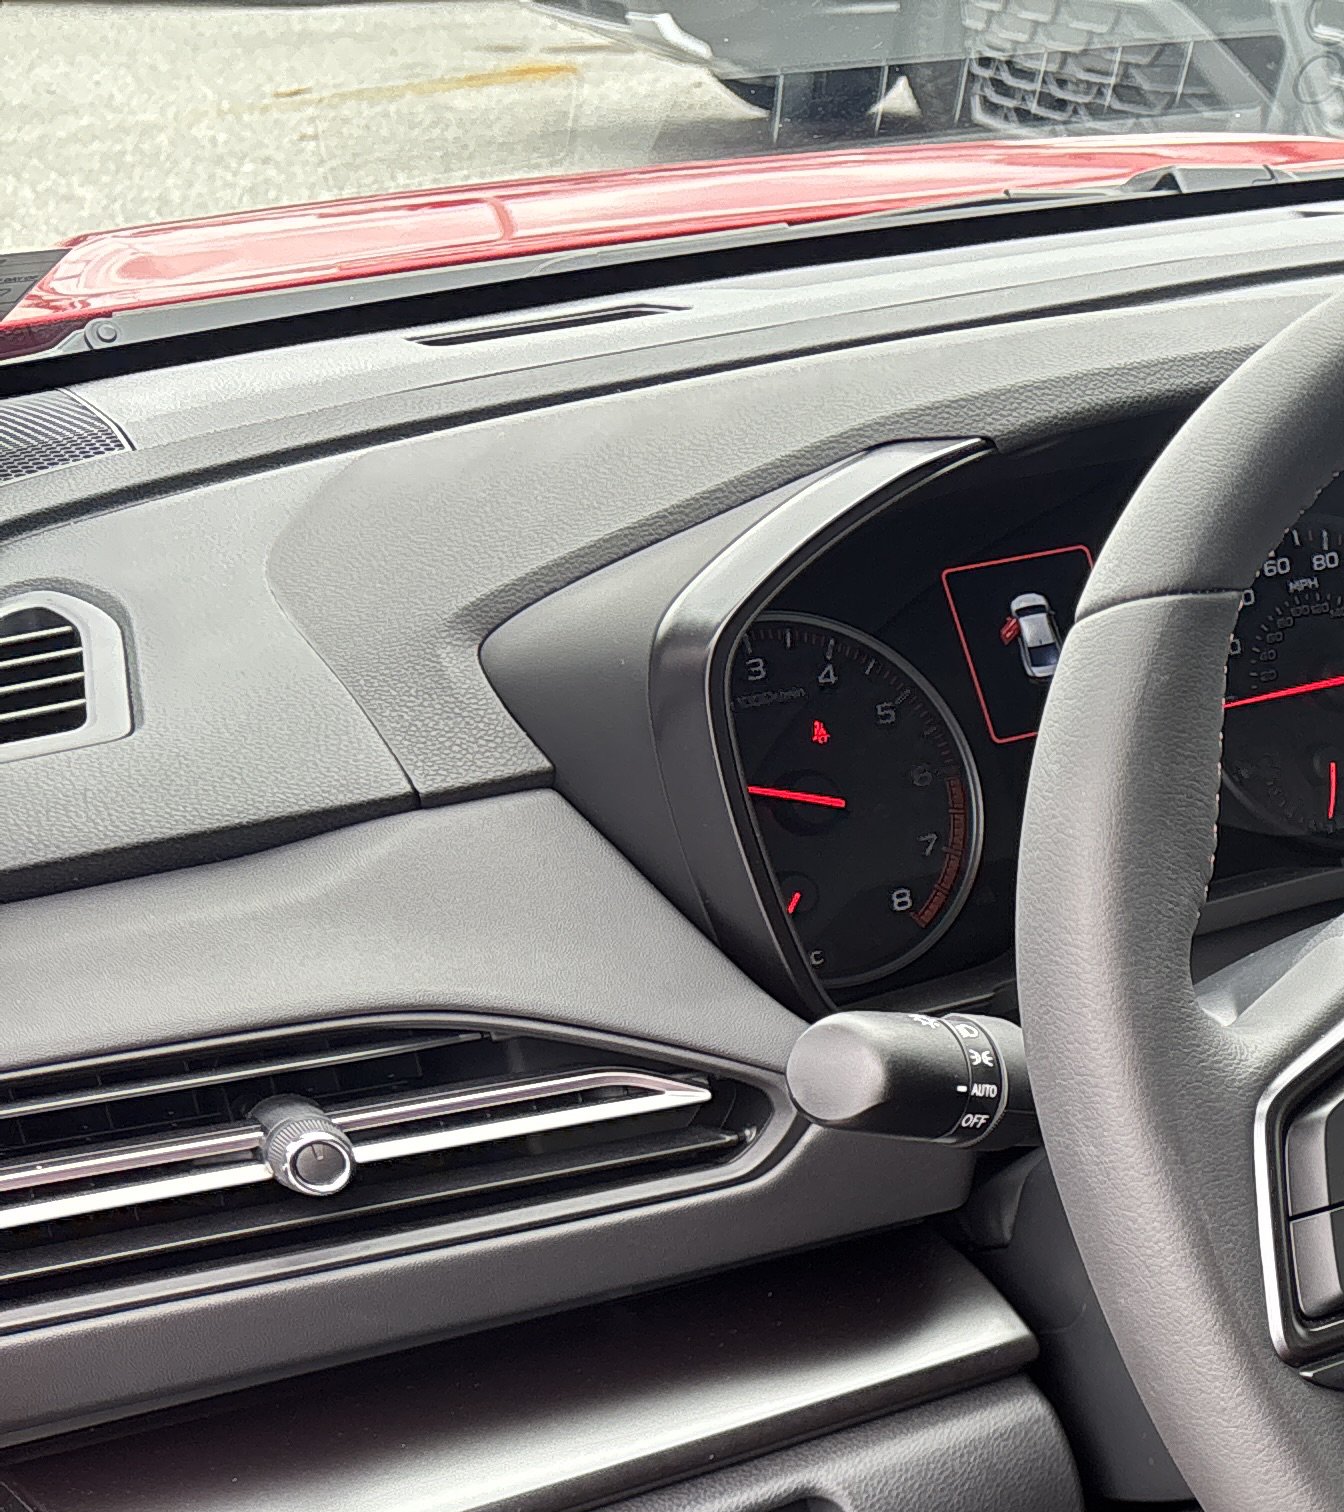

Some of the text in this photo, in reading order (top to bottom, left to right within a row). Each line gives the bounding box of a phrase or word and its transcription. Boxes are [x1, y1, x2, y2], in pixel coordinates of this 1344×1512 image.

[1263, 557, 1291, 577] 60
[1312, 551, 1339, 571] 80
[1287, 576, 1319, 593] MPH
[746, 658, 766, 681] 3
[818, 663, 838, 685] 4
[876, 702, 896, 724] 5
[918, 833, 938, 856] 7
[891, 888, 912, 911] 8
[971, 1083, 998, 1098] AUTO
[961, 1114, 990, 1128] OFF
